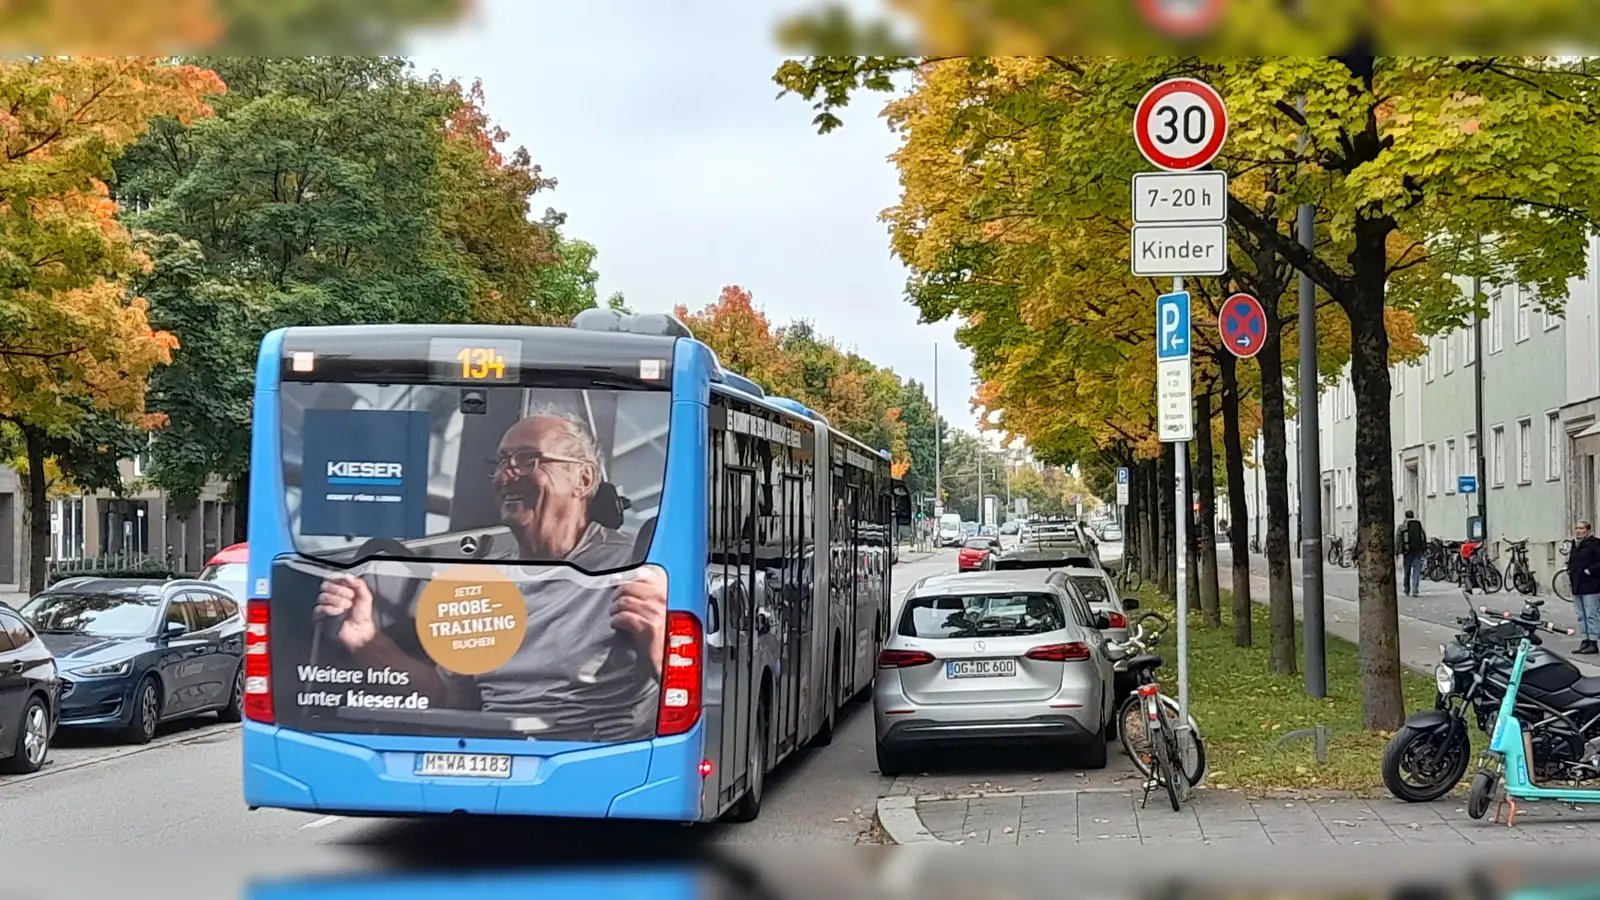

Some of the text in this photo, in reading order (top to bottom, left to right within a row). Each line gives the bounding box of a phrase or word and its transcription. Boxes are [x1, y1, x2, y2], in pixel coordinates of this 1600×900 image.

[1155, 105, 1206, 144] 30
[1148, 188, 1211, 207] 7-20 h
[1142, 240, 1215, 259] Kinder
[1162, 302, 1180, 350] P
[457, 347, 506, 379] 134
[327, 461, 402, 478] KIESER
[454, 585, 483, 598] JETZT
[437, 598, 503, 618] PROBE-
[428, 615, 516, 638] TRAINING
[452, 636, 496, 650] BUCHEN
[297, 664, 410, 686] Weitere Infos
[953, 661, 1014, 674] OG DC 600
[297, 689, 429, 710] unter kieser.de
[446, 756, 466, 771] WA
[469, 756, 510, 773] 1183
